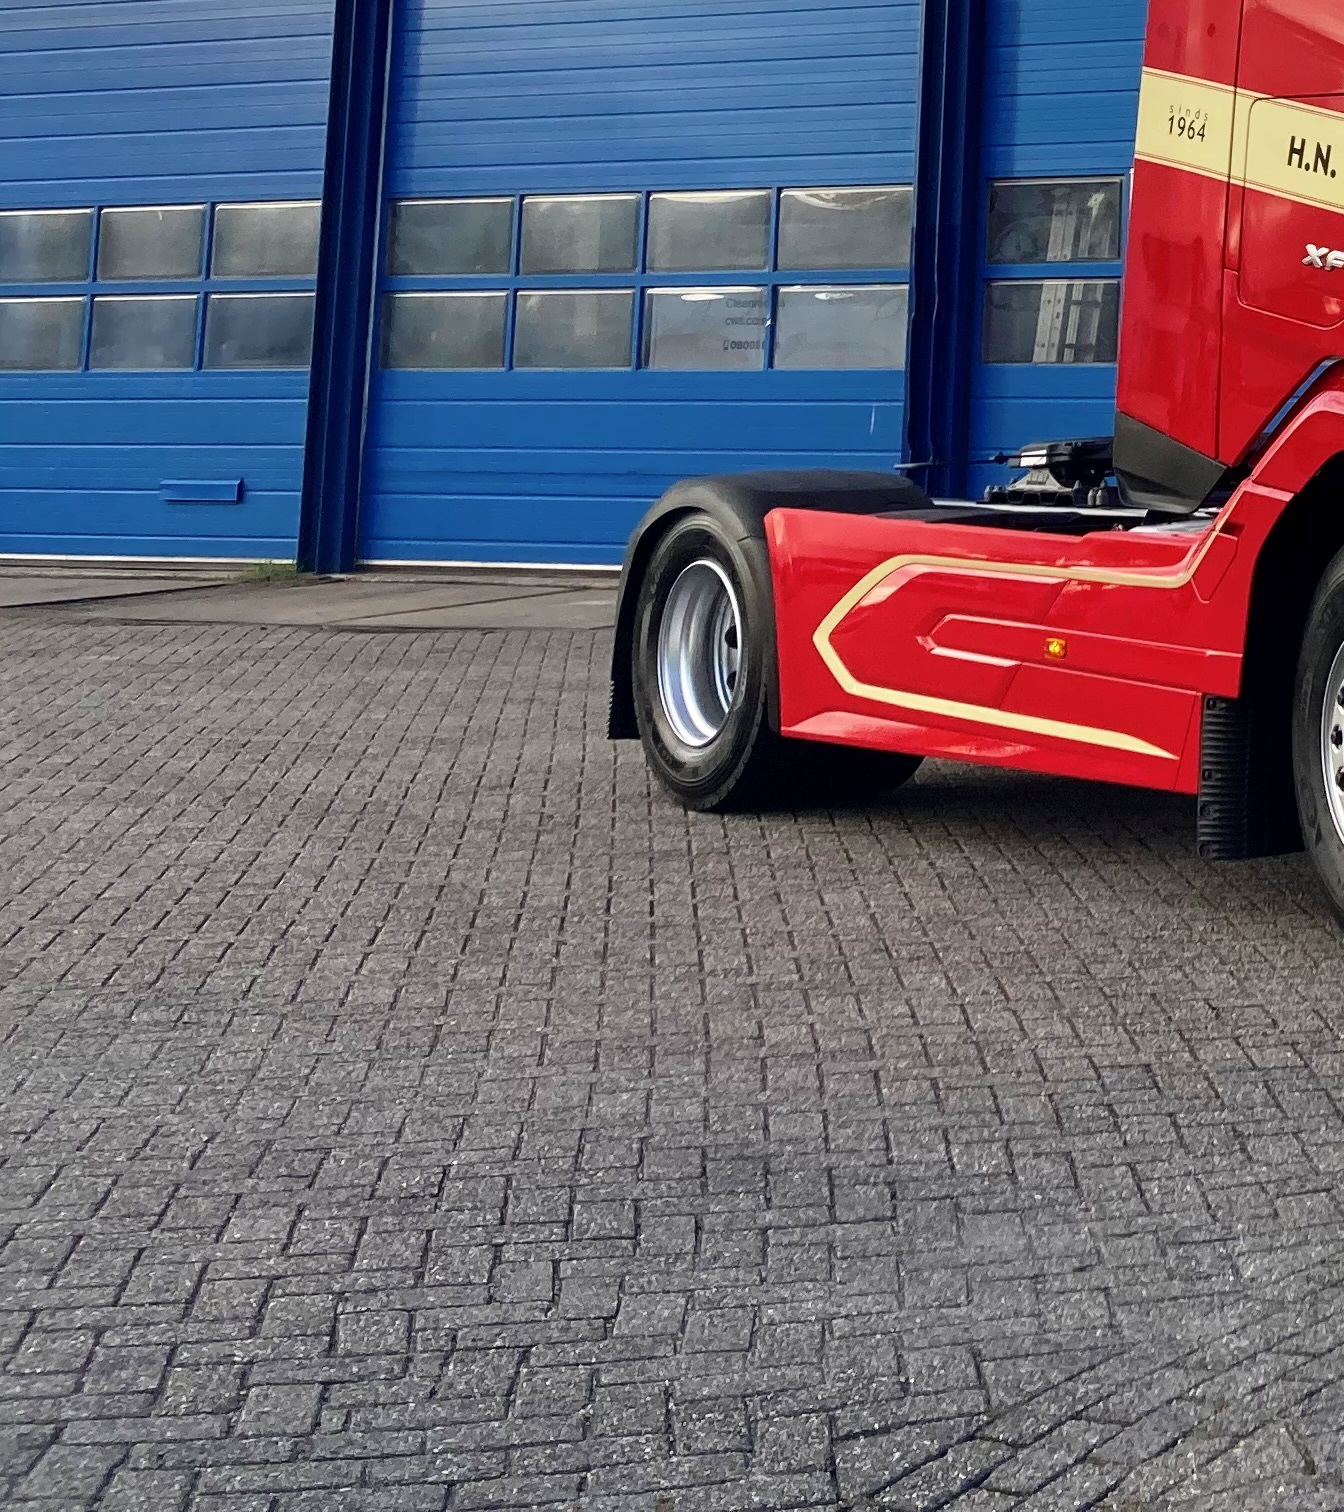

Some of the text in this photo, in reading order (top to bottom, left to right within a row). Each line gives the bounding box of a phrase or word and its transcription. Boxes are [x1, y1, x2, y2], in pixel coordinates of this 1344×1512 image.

[1168, 104, 1209, 121] sinds
[1168, 115, 1206, 142] 1964
[1287, 136, 1336, 178] H.N.
